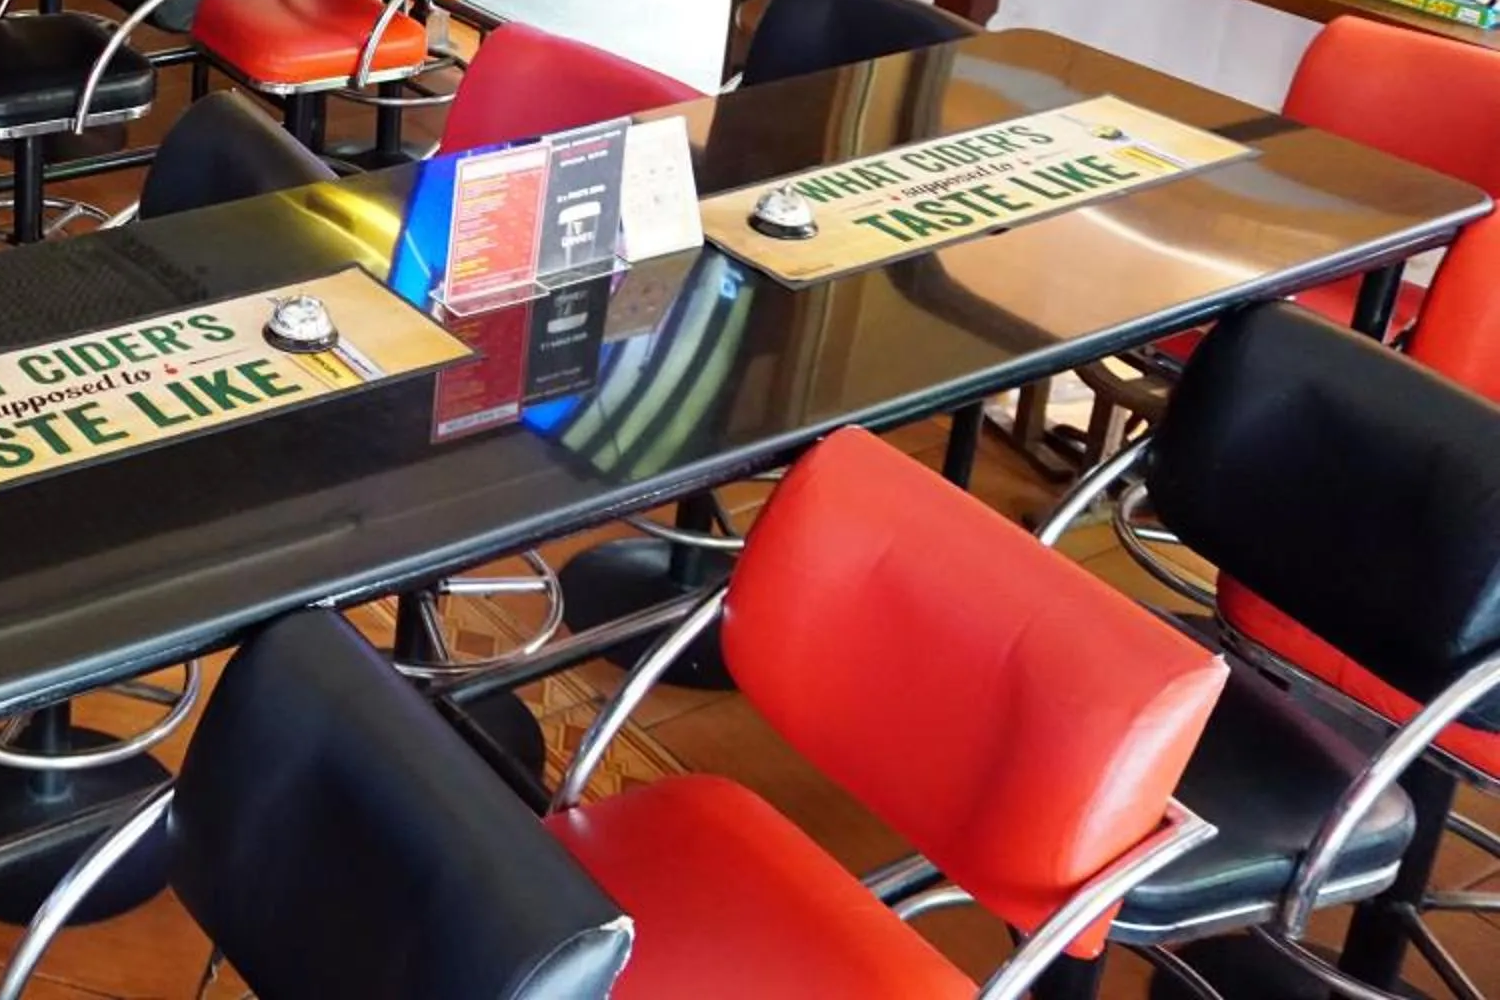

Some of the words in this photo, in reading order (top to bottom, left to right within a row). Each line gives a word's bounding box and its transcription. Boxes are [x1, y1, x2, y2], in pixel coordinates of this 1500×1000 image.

[792, 158, 911, 203] WHAT
[900, 125, 1055, 174] CIDER'S
[851, 183, 1033, 243] TASTE
[1008, 154, 1141, 200] LIKE
[901, 163, 989, 198] supposed
[990, 161, 1015, 174] to
[17, 313, 236, 386] CIDER'S
[121, 369, 152, 386] to
[127, 358, 304, 428] LIKE
